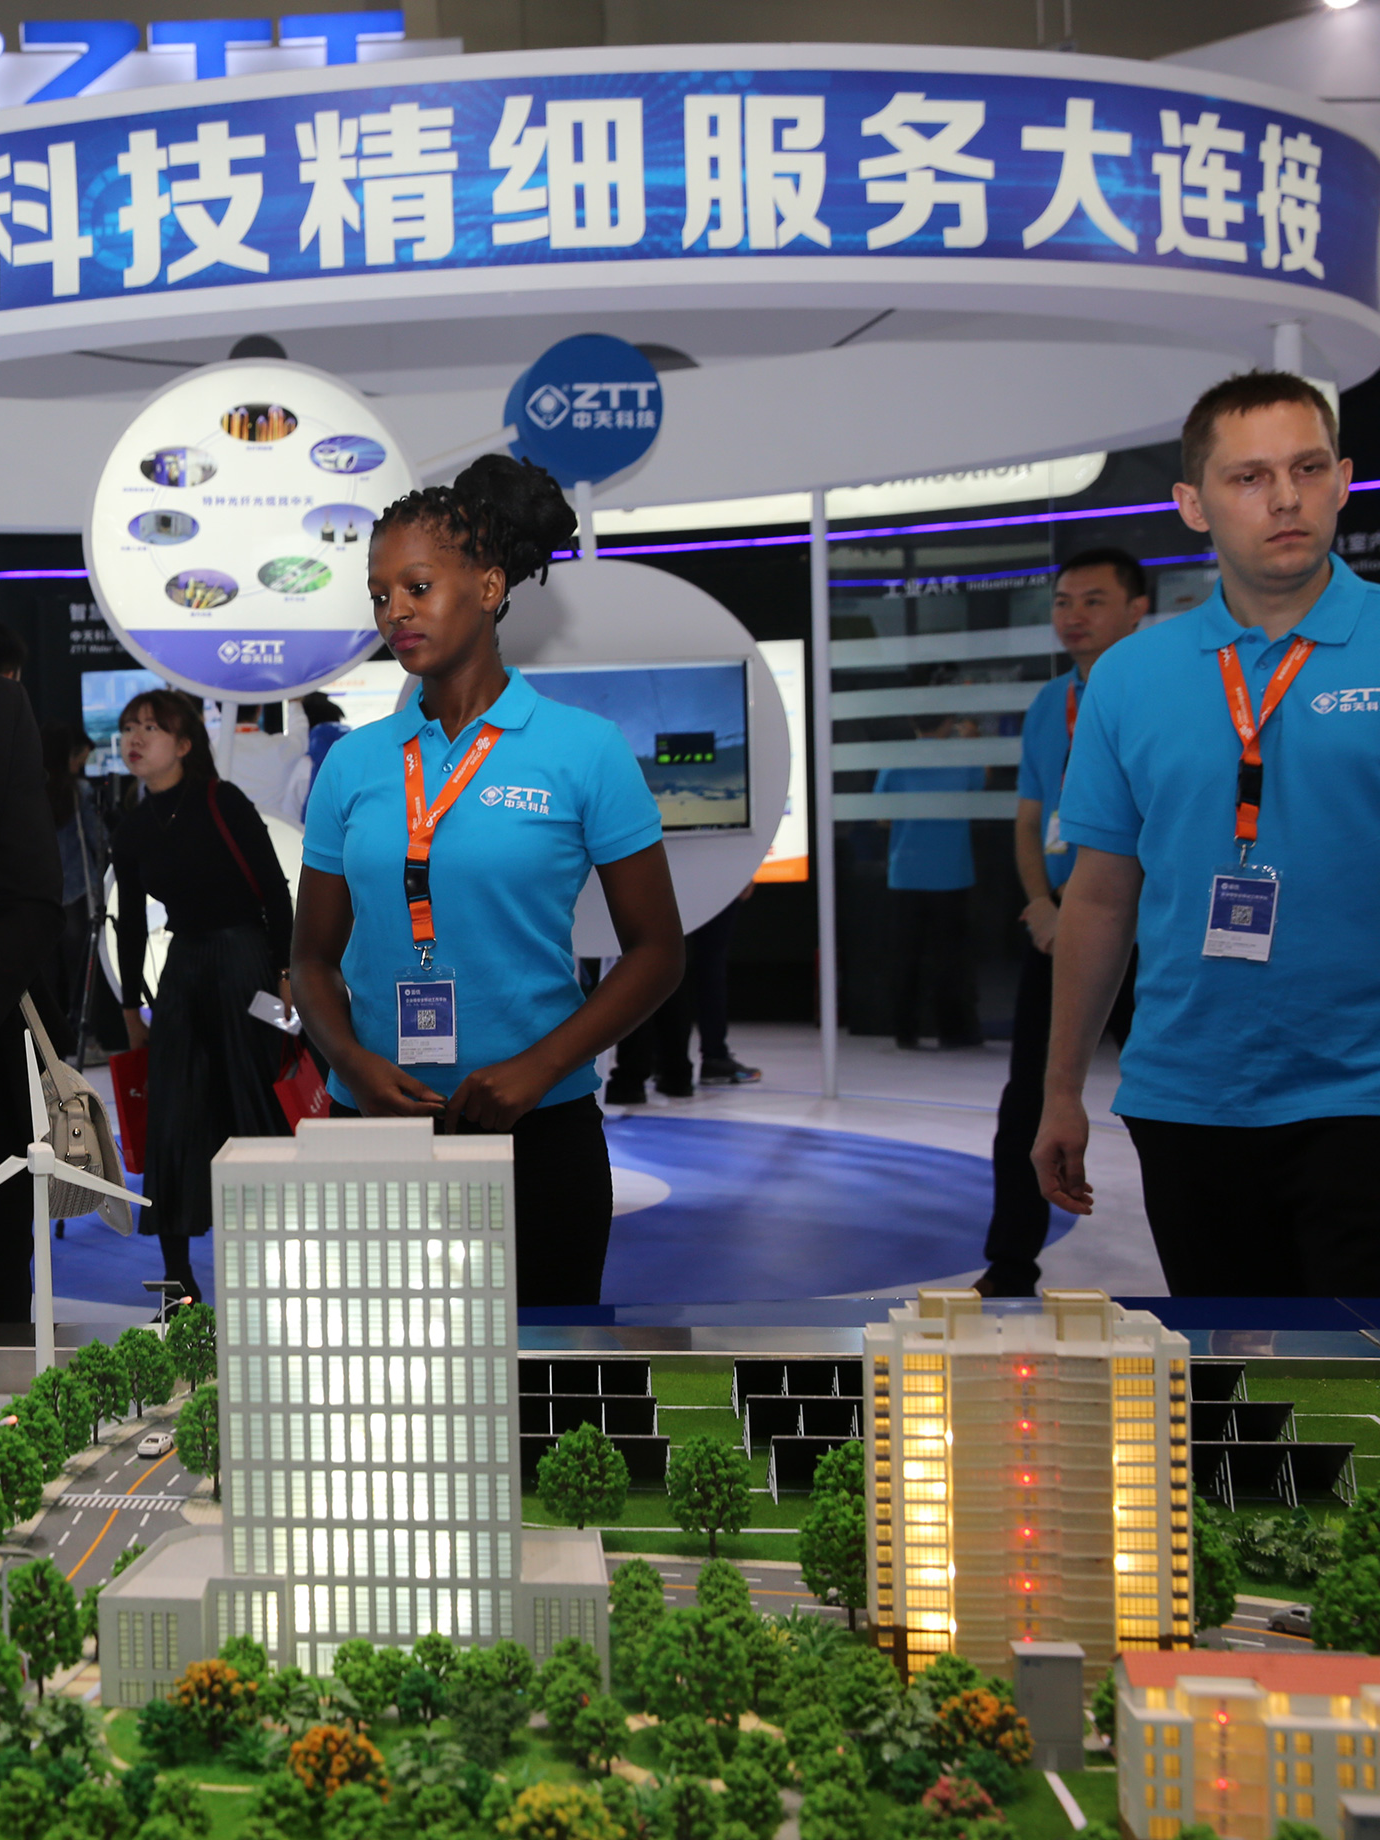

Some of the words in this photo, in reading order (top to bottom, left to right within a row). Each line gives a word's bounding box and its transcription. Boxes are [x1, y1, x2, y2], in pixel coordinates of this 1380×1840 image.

[573, 383, 658, 409] ZTT
[573, 410, 656, 430] 中天科技
[241, 640, 286, 654] ZTT
[1339, 701, 1380, 712] 中天科
[505, 785, 552, 805] ZTT
[504, 799, 551, 816] 中天科技
